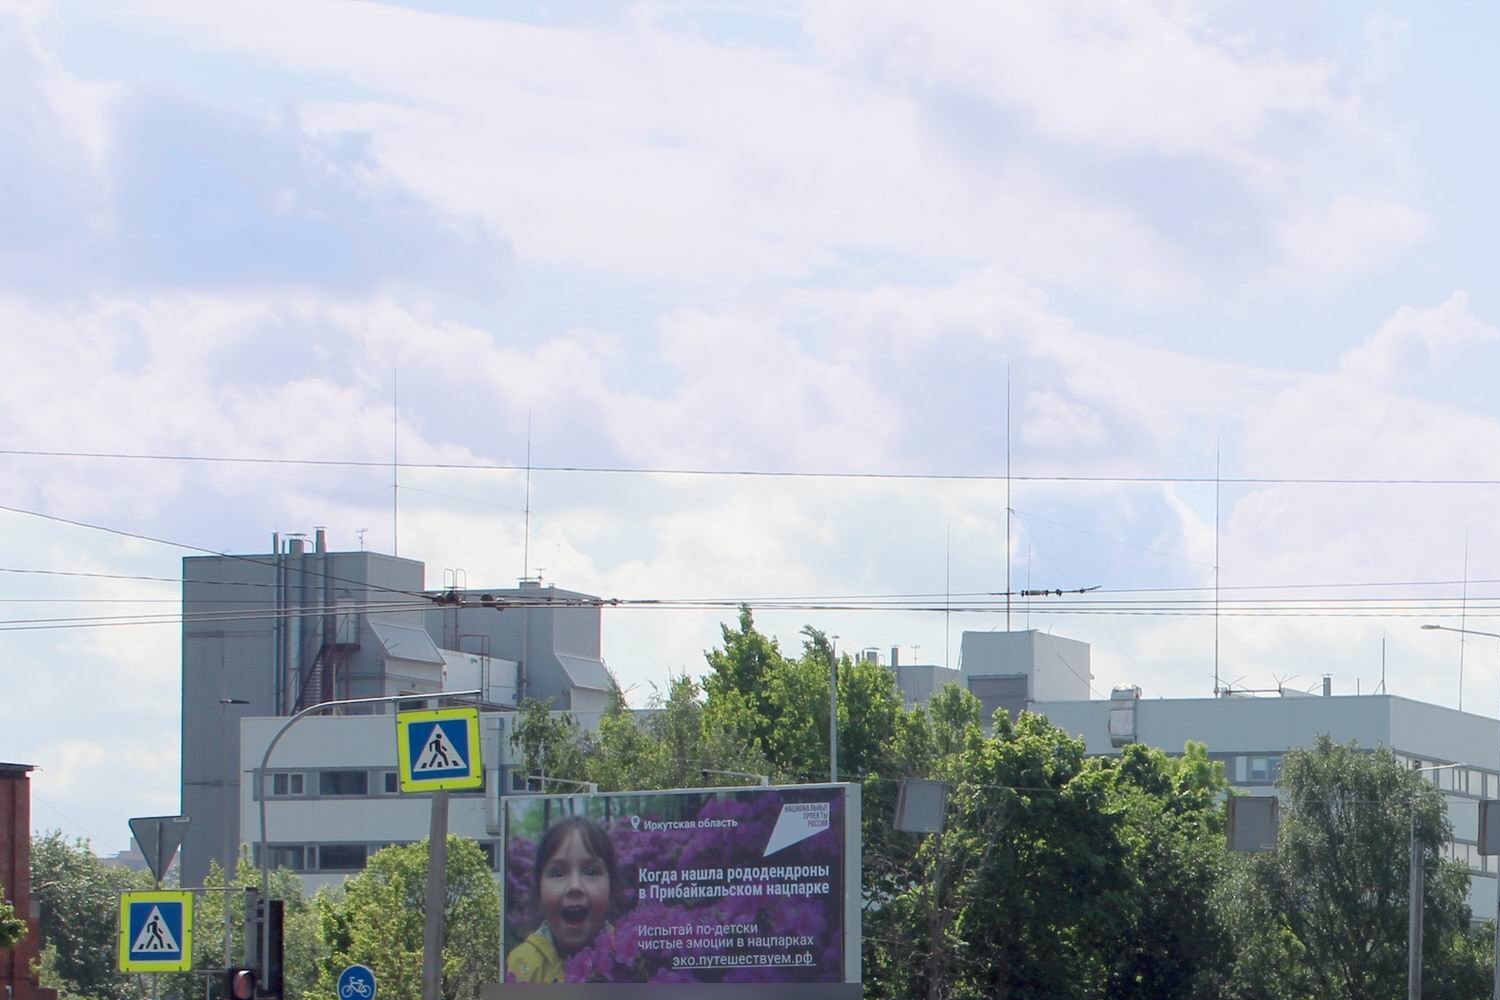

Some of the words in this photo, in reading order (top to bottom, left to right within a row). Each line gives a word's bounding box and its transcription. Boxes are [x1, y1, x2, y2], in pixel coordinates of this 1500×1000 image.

[784, 804, 829, 813] НАЦИОНАЛЬНЫЕ
[803, 811, 829, 820] ПРОЕКТЫ
[643, 818, 695, 831] Иркутская
[697, 817, 738, 829] область
[807, 819, 829, 828] РОССИИ
[639, 868, 678, 884] Когда
[681, 867, 723, 881] нашла
[726, 864, 830, 883] рододендроны
[639, 889, 646, 899] в
[650, 883, 763, 901] Прибайкальском
[766, 883, 830, 899] нацпарке
[638, 923, 693, 937] Испытай
[696, 923, 758, 937] по-детски
[638, 938, 683, 950] чистые
[686, 937, 734, 950] эмоции
[737, 938, 745, 948] в
[747, 935, 814, 949] нацпарках
[672, 951, 814, 968] эко.путешествуем.рф
